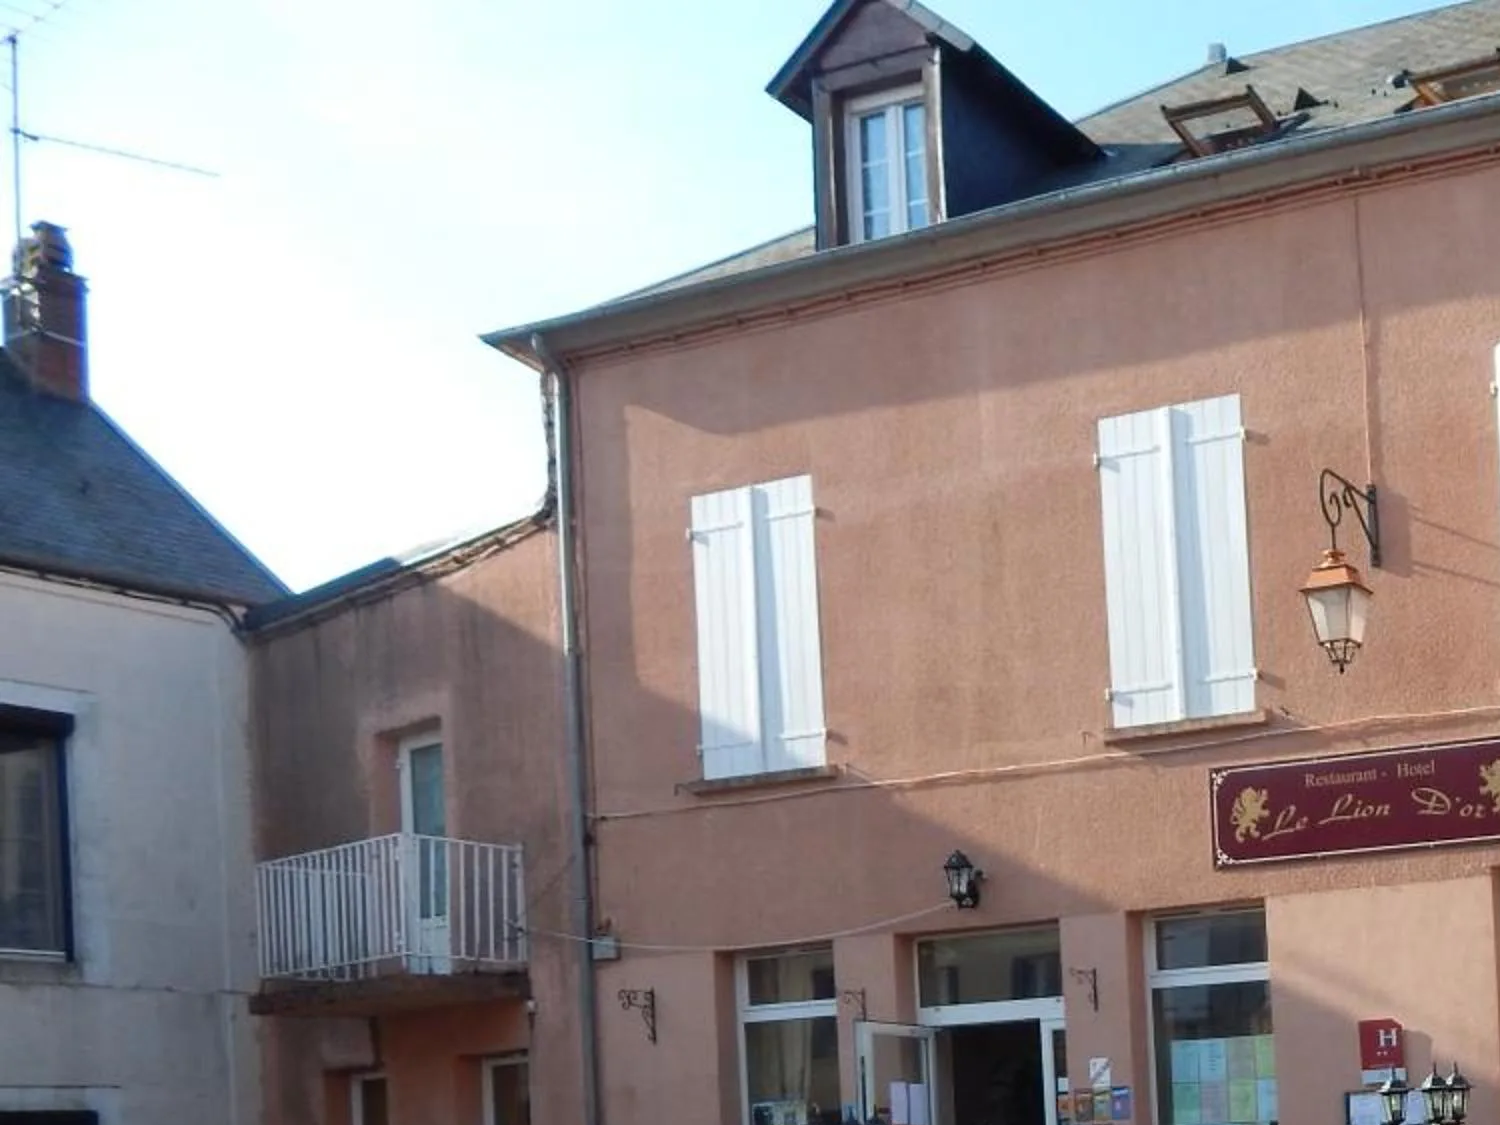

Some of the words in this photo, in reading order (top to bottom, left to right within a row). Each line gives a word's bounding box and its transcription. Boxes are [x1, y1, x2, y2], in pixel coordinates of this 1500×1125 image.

[1304, 768, 1377, 789] Restaurant
[1261, 804, 1308, 841] Le
[1318, 793, 1390, 826] Lion
[1379, 1028, 1397, 1047] H
